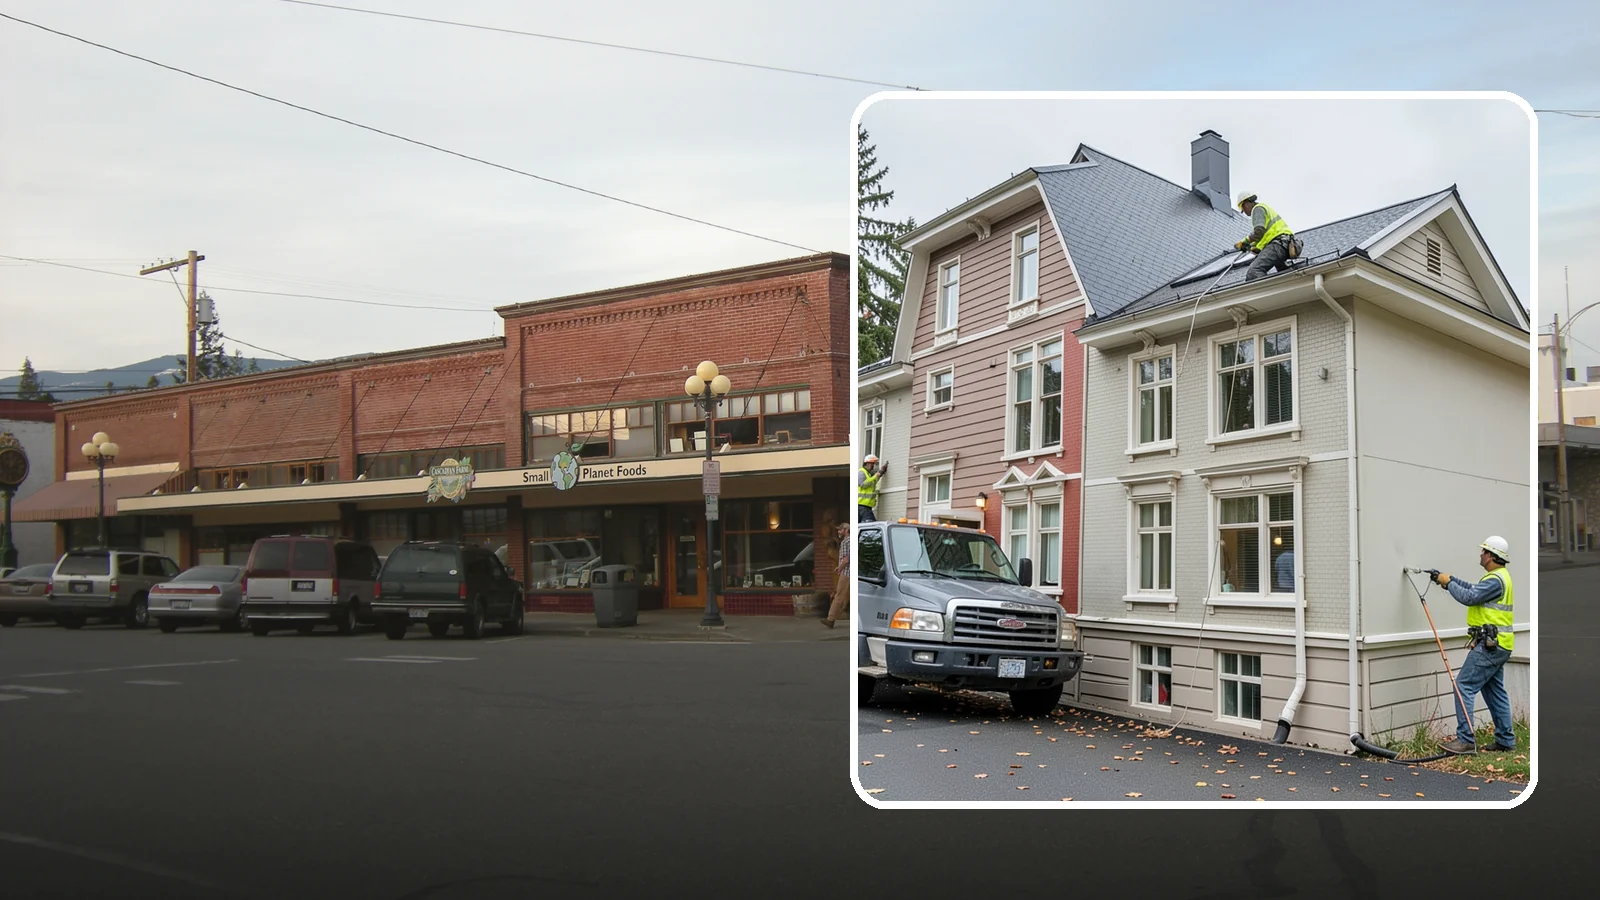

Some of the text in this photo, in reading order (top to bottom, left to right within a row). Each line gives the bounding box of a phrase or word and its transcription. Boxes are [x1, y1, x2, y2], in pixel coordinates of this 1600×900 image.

[523, 464, 647, 482] Small Planet Foods
